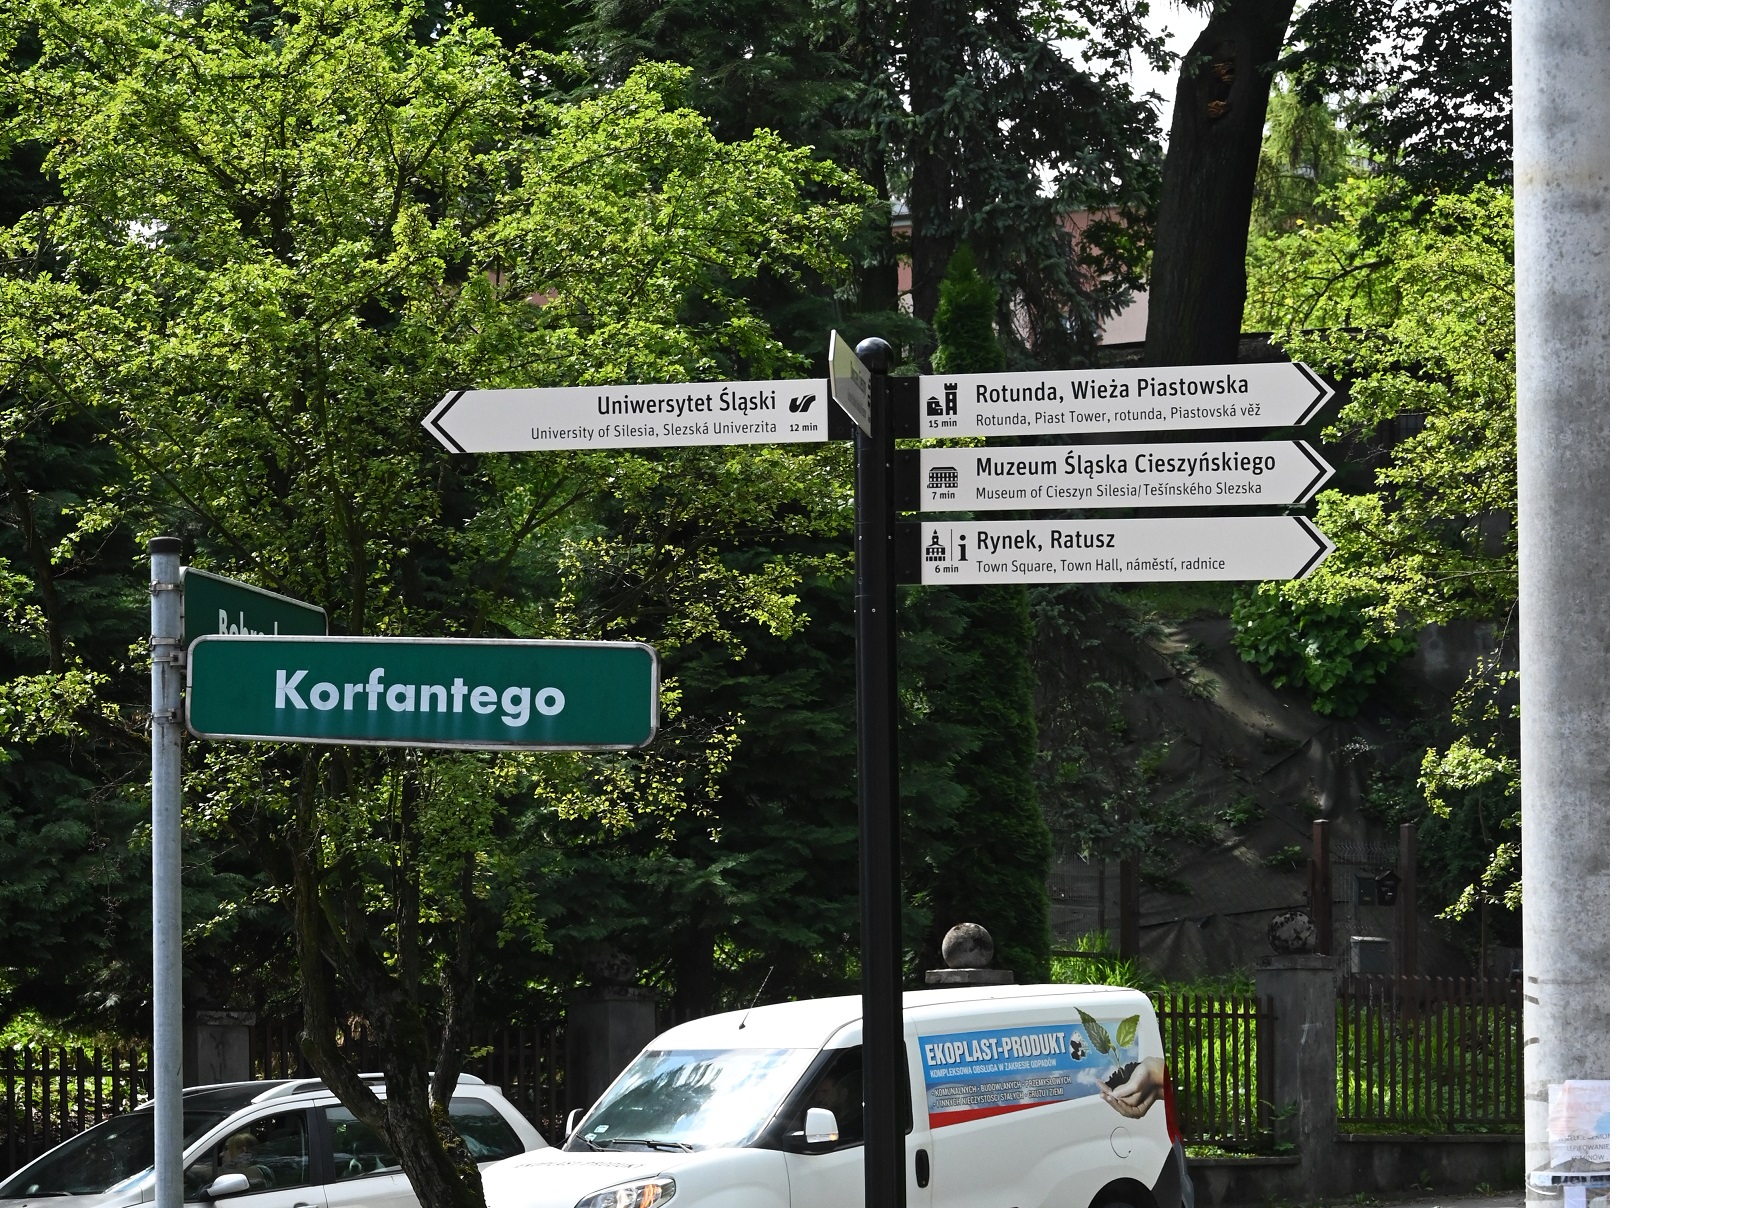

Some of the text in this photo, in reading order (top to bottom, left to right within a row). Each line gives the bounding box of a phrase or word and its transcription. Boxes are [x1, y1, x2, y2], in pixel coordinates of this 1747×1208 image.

[976, 374, 1249, 404] Rotunda, Wieża Piastowska
[597, 386, 776, 418] Uniwersytet Śląski
[927, 417, 958, 429] 15 min
[976, 402, 1261, 427] Rotunda, Piast Tower, rotunda, Piastovská věž
[531, 421, 777, 442] University of Silesia, Slezská Univerzita
[789, 422, 818, 433] 12 min
[976, 449, 1276, 480] Muzeum Śląska Cieszyńskiego
[931, 489, 956, 501] 7 min
[976, 480, 1262, 501] Museum of Cieszyn Silesia/Tešínského Slezska
[977, 529, 1115, 555] Rynek, Ratusz
[934, 565, 959, 574] 6 min
[976, 556, 1226, 576] Town Square, Town Hall, náměstí, radnice
[274, 667, 566, 728] Korfantego
[924, 1032, 1068, 1067] EKOPLAST-PRODUKT
[998, 1062, 1005, 1071] W
